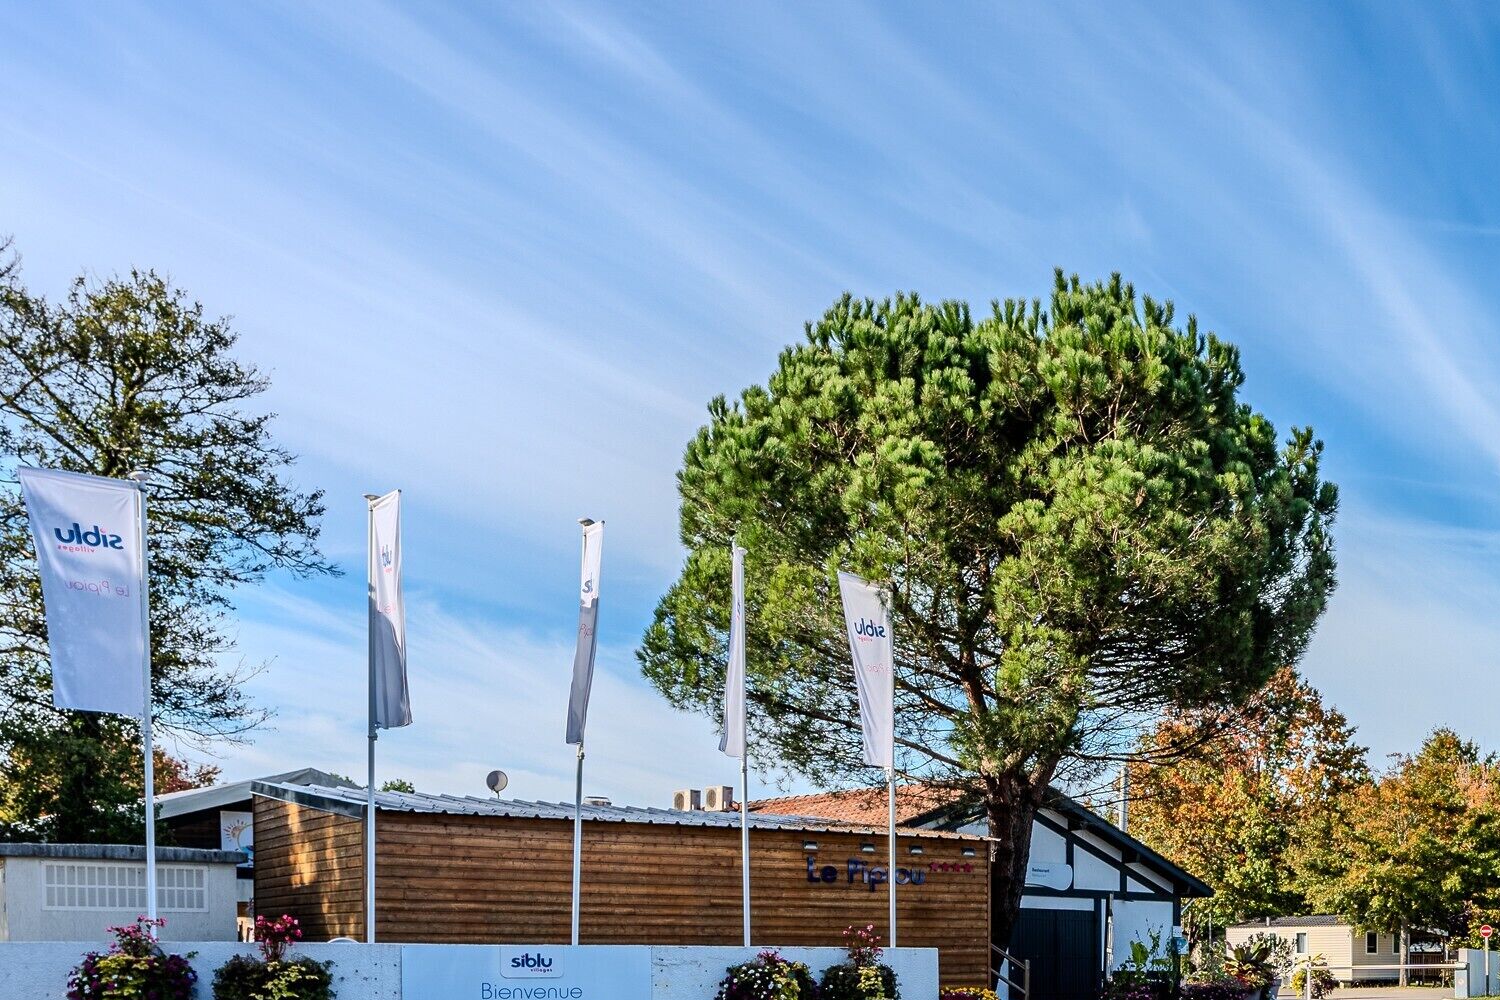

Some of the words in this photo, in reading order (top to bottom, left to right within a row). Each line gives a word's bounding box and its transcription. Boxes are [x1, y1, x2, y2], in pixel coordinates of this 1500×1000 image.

[806, 855, 838, 883] Le
[510, 953, 553, 968] siblu
[481, 982, 583, 1000] Bienvenue
